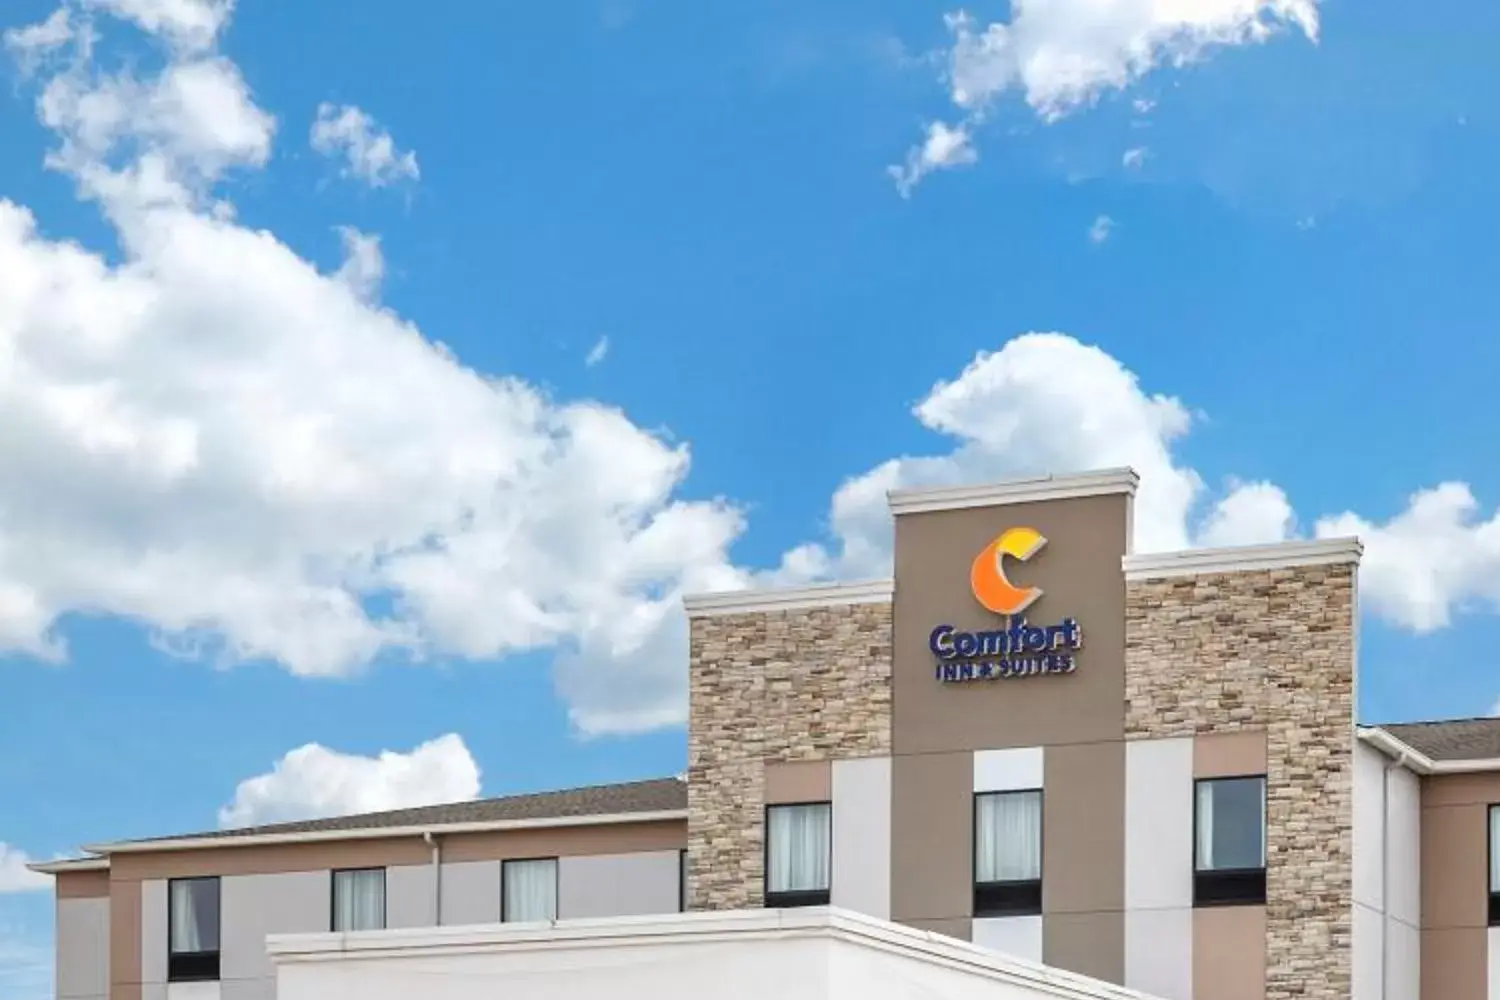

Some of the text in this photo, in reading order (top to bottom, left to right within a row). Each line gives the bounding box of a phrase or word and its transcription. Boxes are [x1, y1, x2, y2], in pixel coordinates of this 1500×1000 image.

[930, 616, 1081, 658] Comfort
[936, 661, 977, 682] INN
[1000, 654, 1076, 677] SUITES
